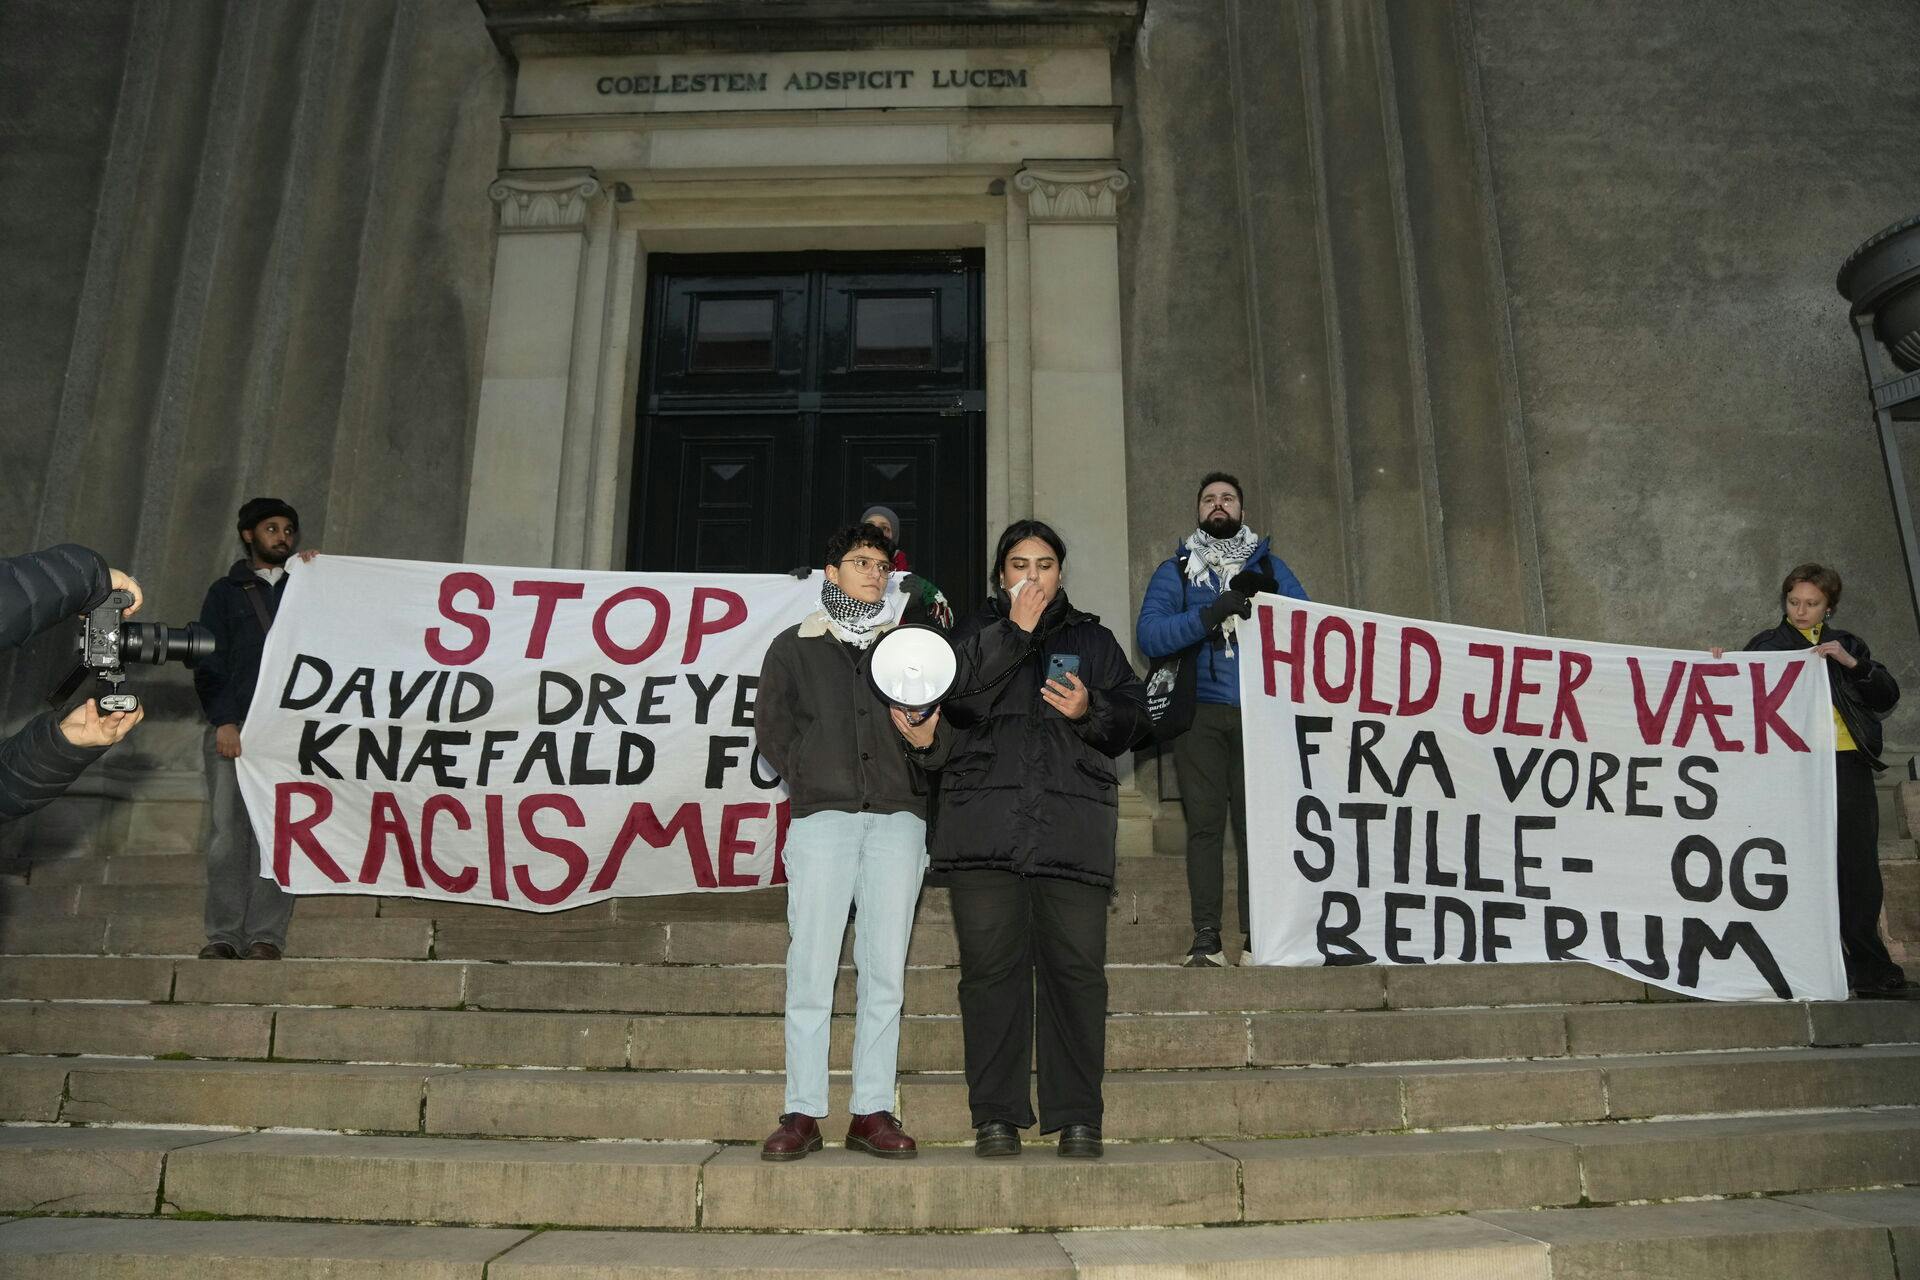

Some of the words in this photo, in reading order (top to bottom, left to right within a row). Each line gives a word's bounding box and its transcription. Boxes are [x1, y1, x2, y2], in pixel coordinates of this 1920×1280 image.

[597, 72, 767, 95] COELESTEM
[784, 70, 914, 90] ADSPICIT
[932, 68, 1028, 89] LUCEM
[424, 572, 748, 666] STOP
[279, 653, 494, 724] DAVID
[1258, 605, 1442, 717] HOLD
[1462, 643, 1592, 742] JER
[1627, 657, 1811, 755] VÆK
[298, 719, 656, 790] KNÆFALD
[1295, 715, 1457, 799] FRA
[1493, 746, 1721, 821] VORES
[1293, 794, 1594, 901] STILLE-
[1671, 834, 1789, 912] OG
